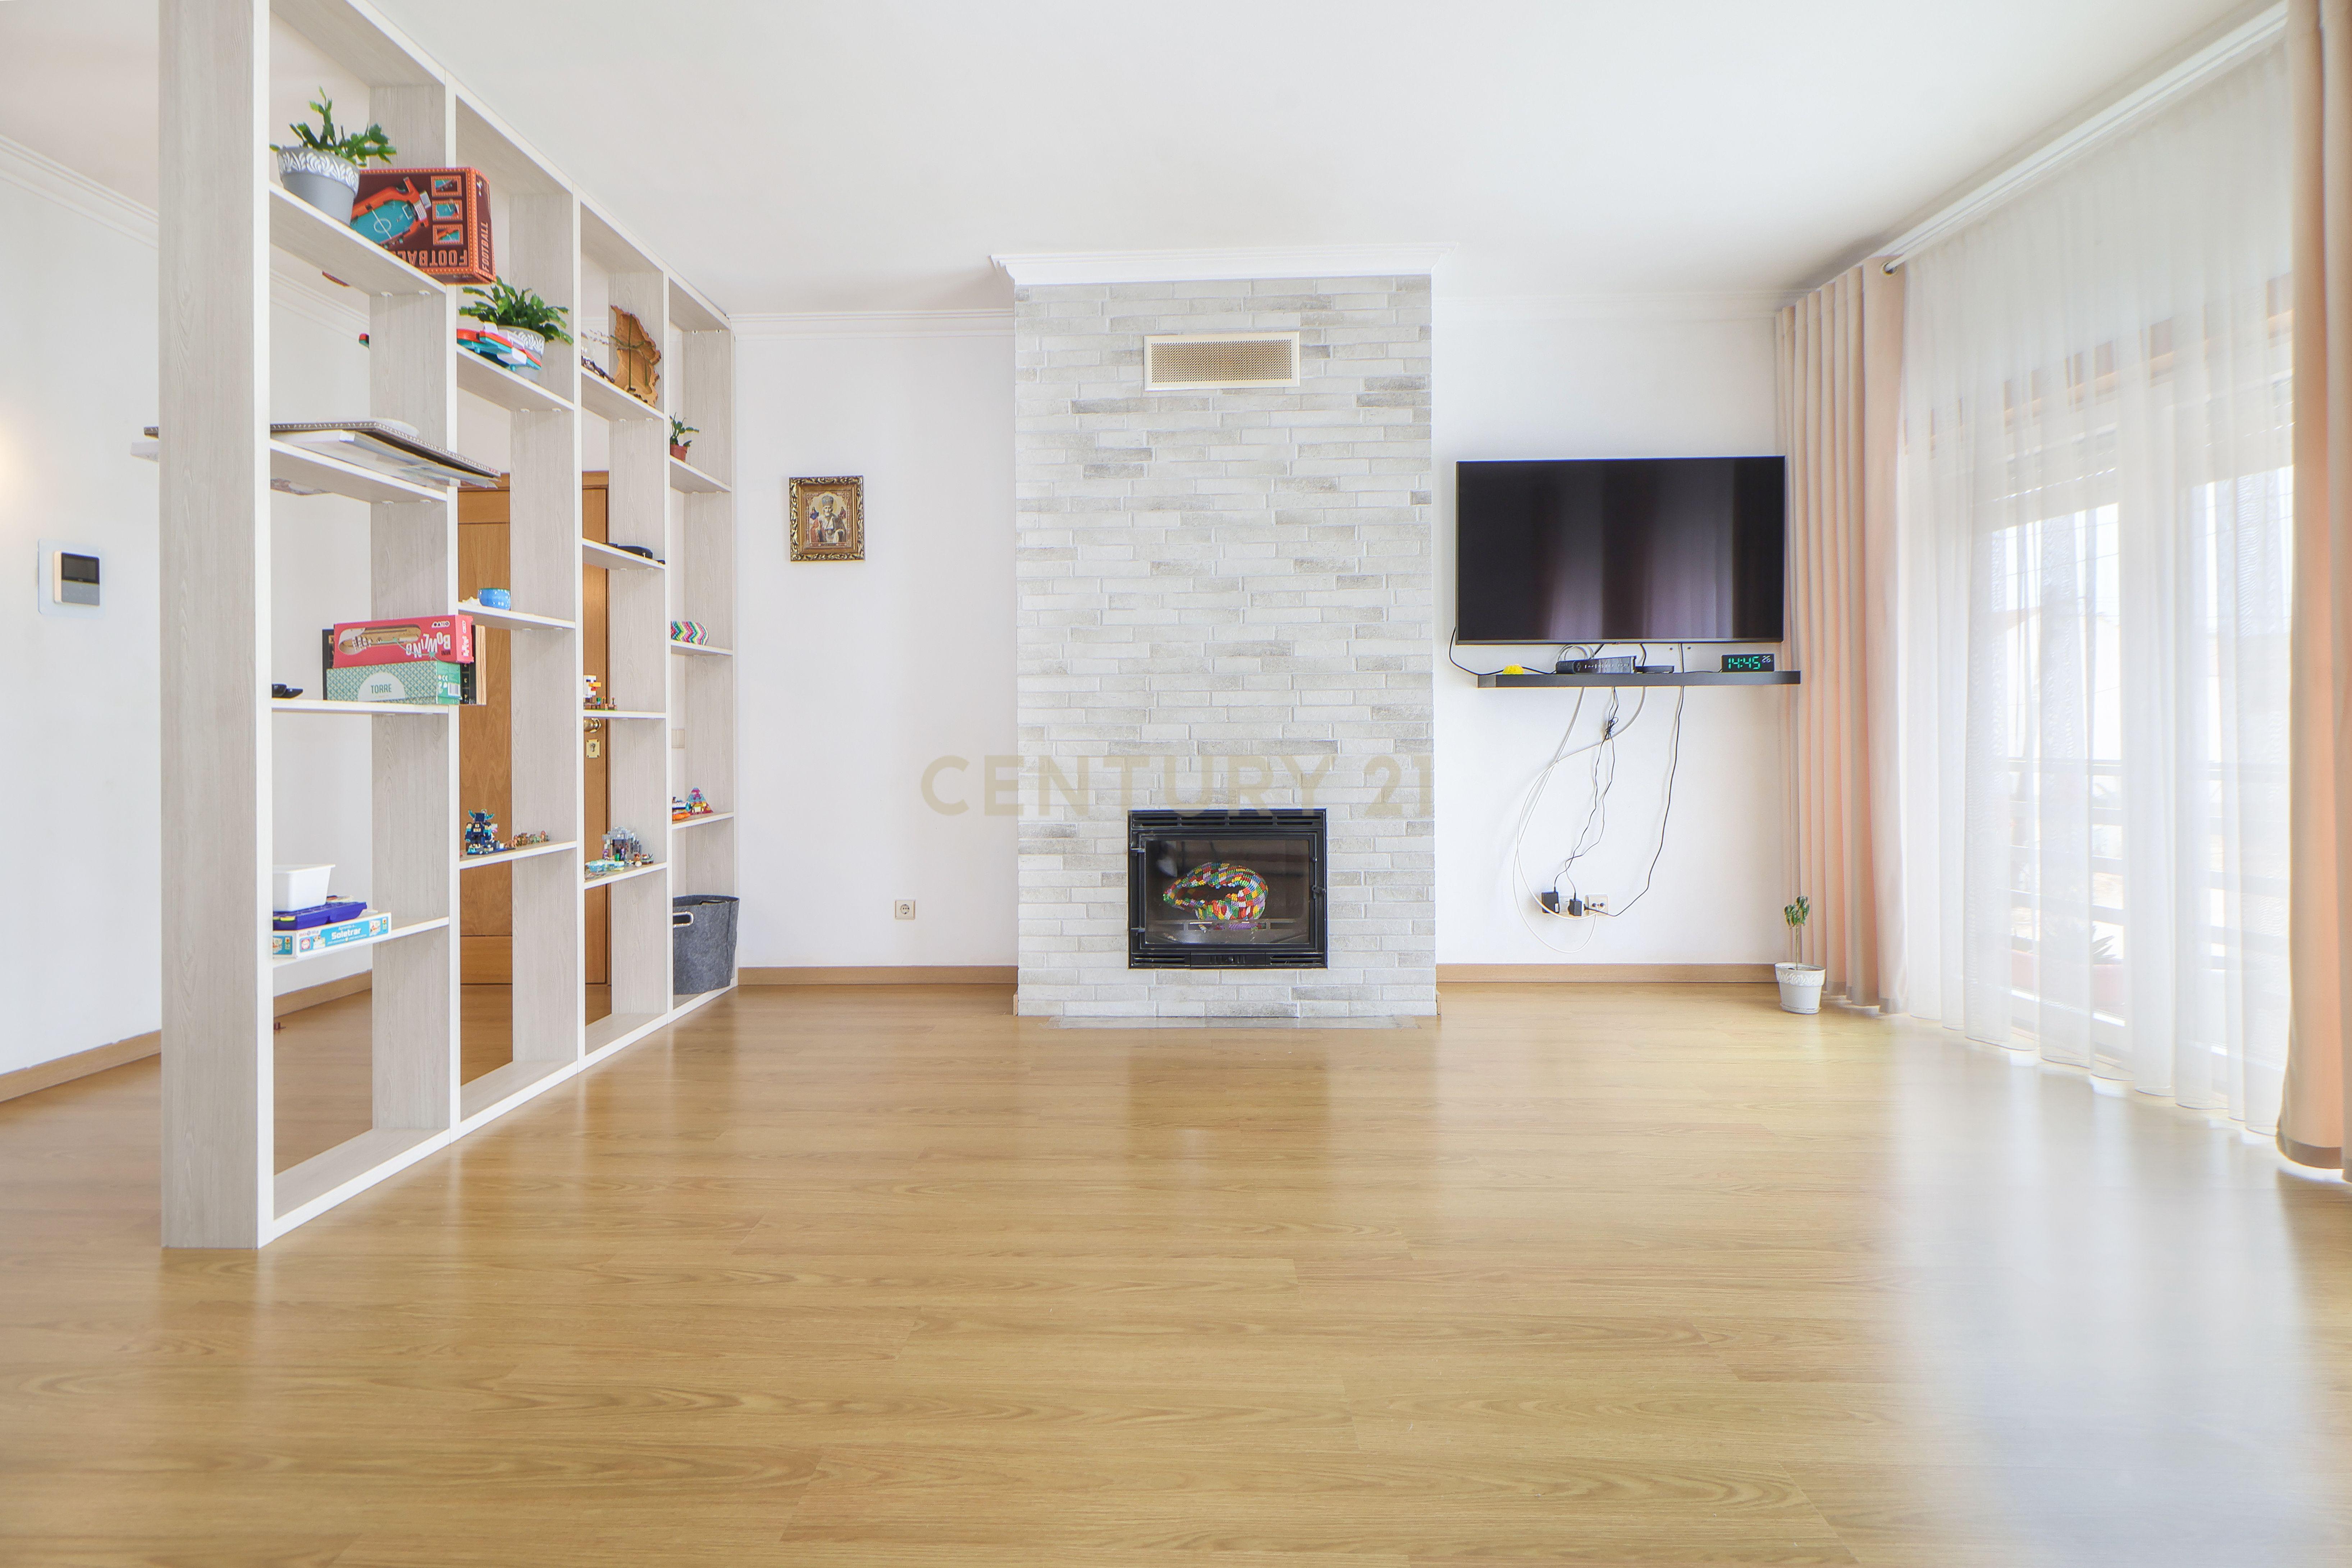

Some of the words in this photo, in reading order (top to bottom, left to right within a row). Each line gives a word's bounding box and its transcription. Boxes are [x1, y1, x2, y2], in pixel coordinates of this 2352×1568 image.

[481, 221, 490, 272] FOOTBALL
[391, 250, 467, 267] FOOTBAL
[1728, 656, 1761, 670] 14:45
[370, 684, 392, 694] TORRE
[331, 927, 361, 940] Soletrar
